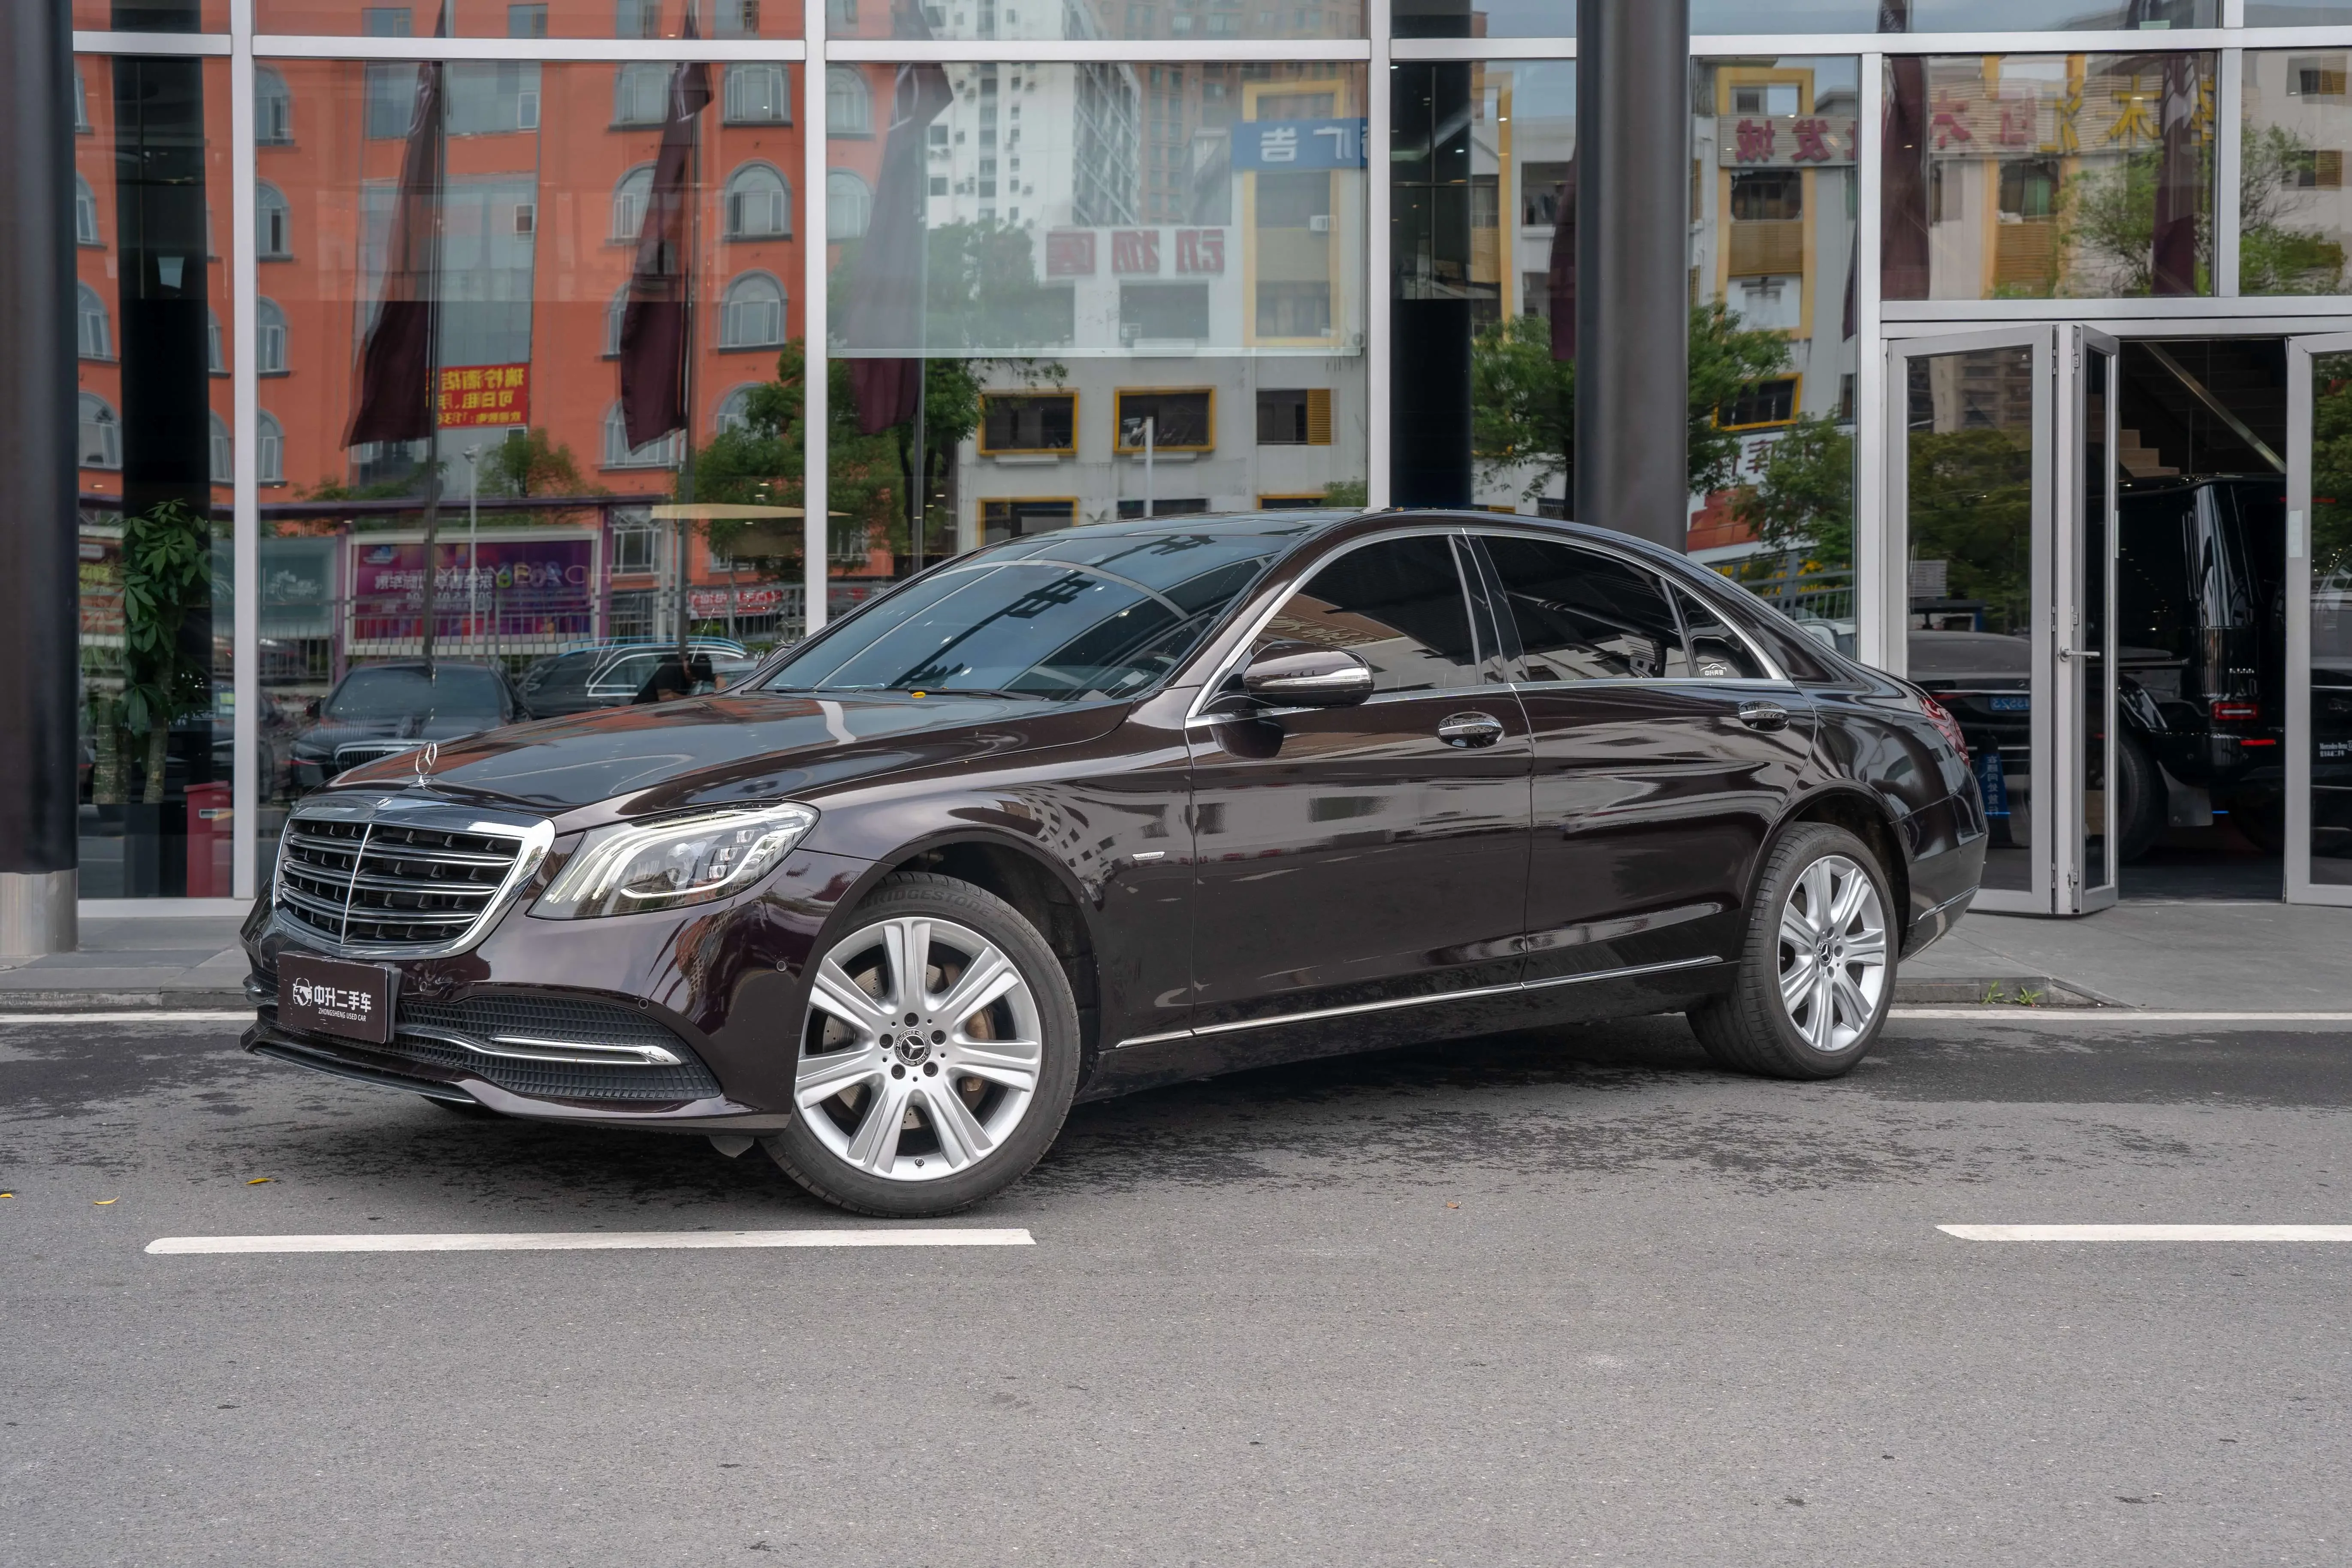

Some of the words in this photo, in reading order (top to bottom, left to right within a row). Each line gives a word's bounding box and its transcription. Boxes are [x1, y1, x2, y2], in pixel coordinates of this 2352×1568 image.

[314, 985, 371, 1012] 中升二手车
[318, 1007, 345, 1018] ZHONGSHENG
[896, 1030, 915, 1047] MERCEDES
[916, 1054, 927, 1064] BENZ
